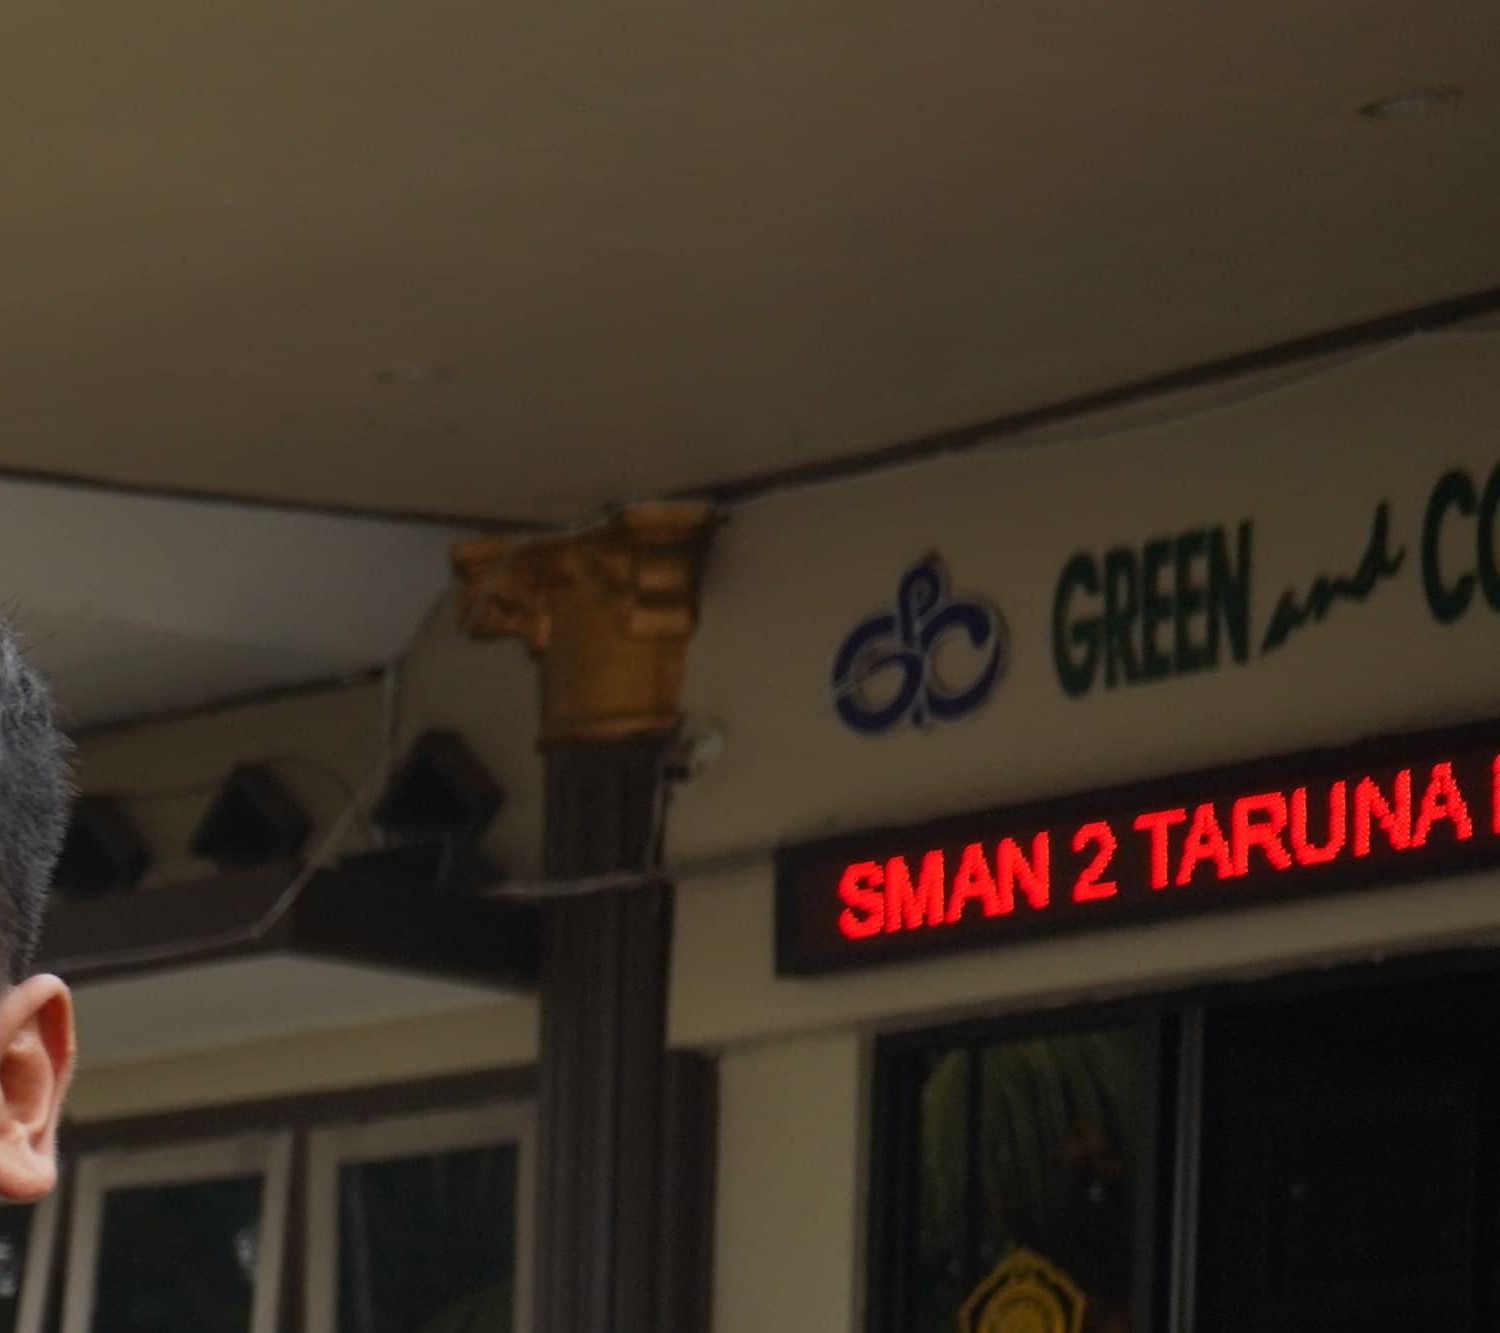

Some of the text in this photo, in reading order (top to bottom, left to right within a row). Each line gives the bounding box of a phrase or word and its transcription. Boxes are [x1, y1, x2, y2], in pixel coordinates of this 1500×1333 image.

[1051, 517, 1254, 699] GREEN
[1259, 498, 1406, 656] and
[837, 831, 1050, 940] SMAN
[1072, 821, 1118, 903] 2
[1134, 761, 1474, 891] TARUNA
